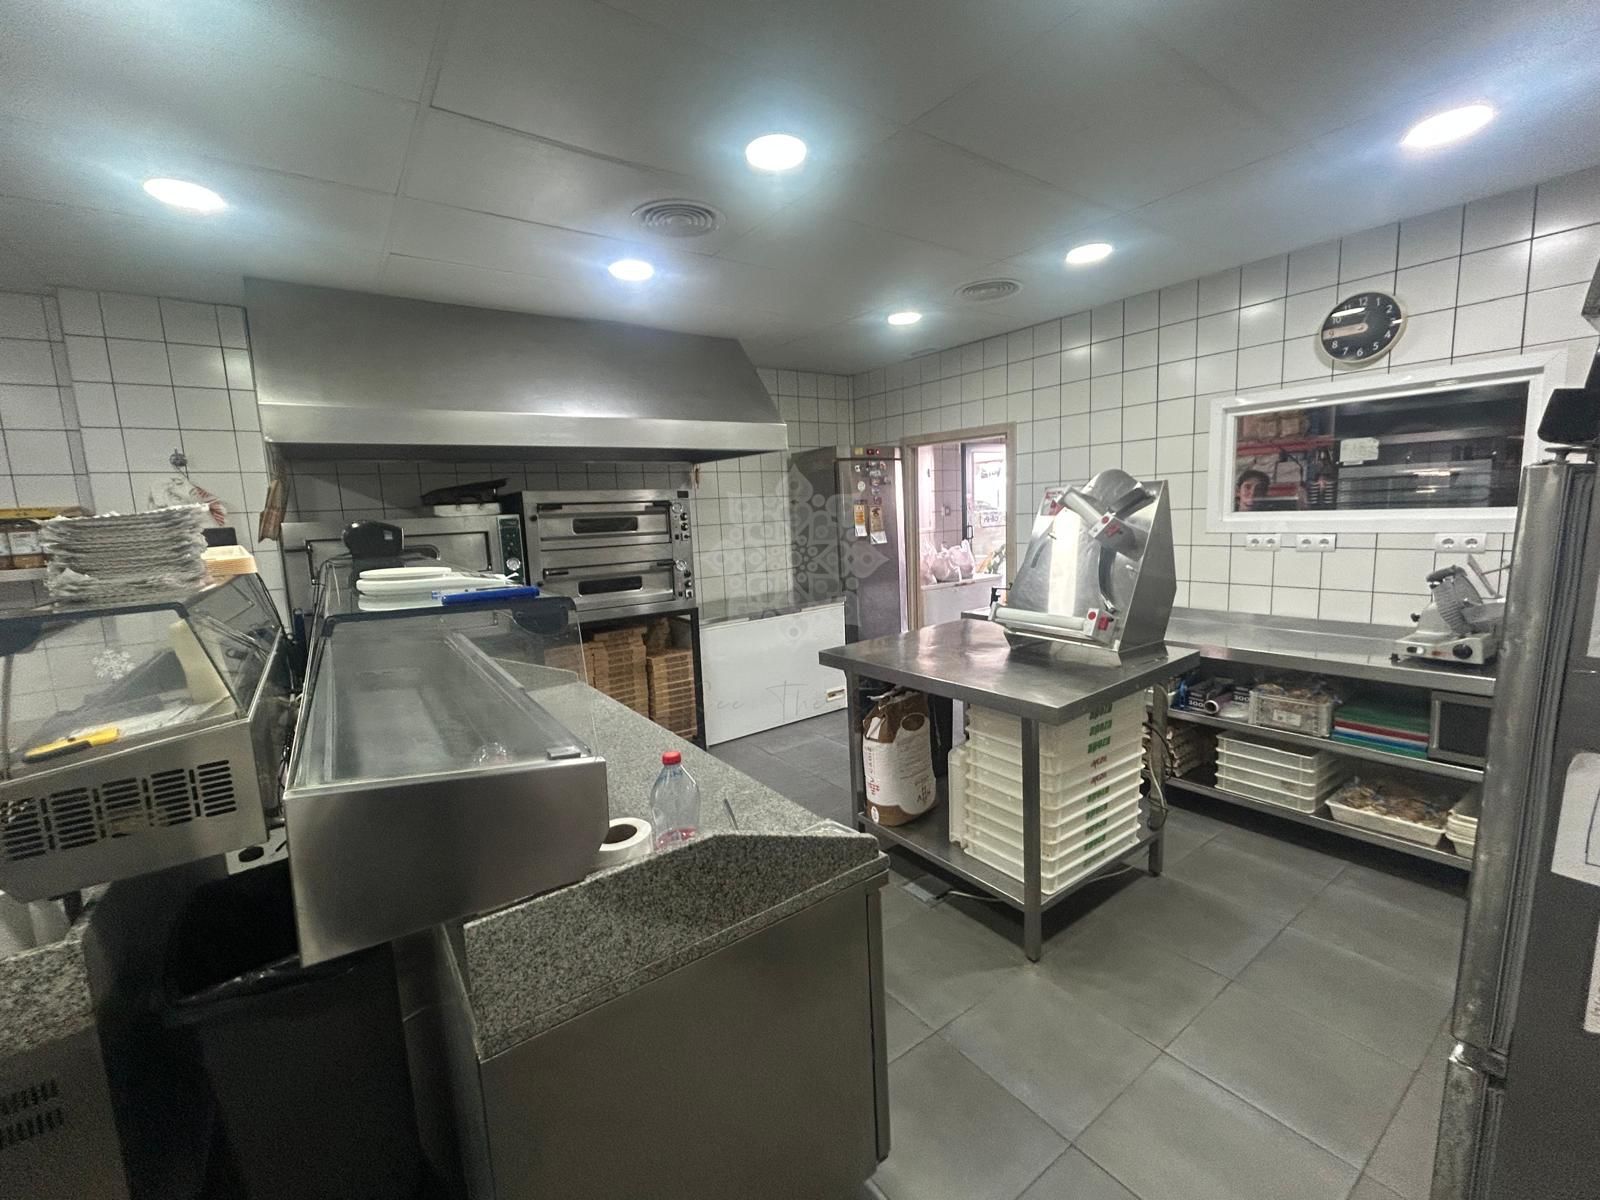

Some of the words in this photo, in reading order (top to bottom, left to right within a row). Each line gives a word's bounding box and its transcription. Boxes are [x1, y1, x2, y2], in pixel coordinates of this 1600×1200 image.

[1358, 296, 1368, 306] 12
[1376, 298, 1380, 306] 1
[1386, 304, 1392, 313] 2
[1384, 330, 1390, 338] 4
[1332, 340, 1338, 348] 8
[1372, 342, 1379, 350] 5
[1342, 347, 1348, 356] 7
[1356, 348, 1364, 356] 6
